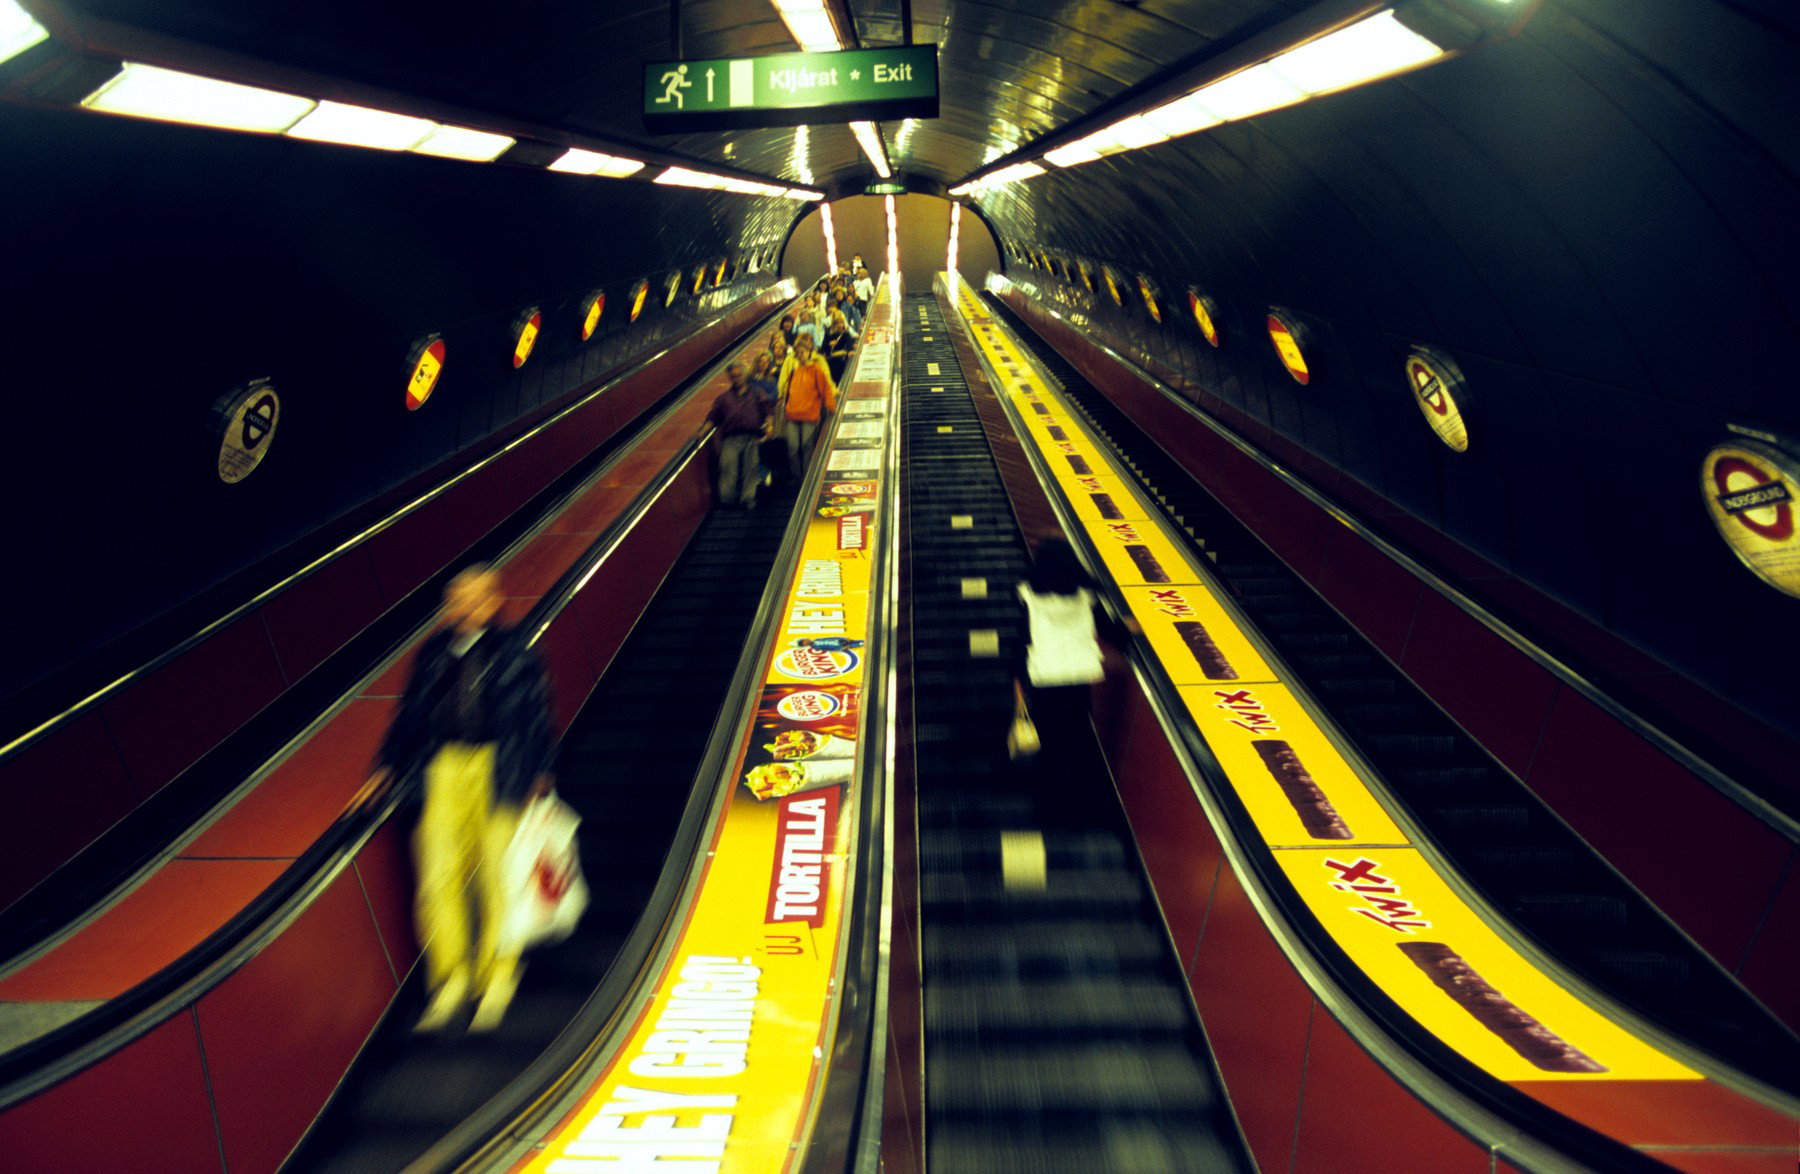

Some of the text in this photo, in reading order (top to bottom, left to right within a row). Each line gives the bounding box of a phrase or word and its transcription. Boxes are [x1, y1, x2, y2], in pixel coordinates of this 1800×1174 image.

[873, 63, 912, 83] Exit
[787, 600, 846, 634] HEY
[793, 649, 818, 675] BURGER
[801, 695, 825, 716] KING
[773, 797, 826, 920] TORTILLA
[755, 935, 804, 955] ÚJ
[544, 955, 763, 1174] HEY GRINGO!
